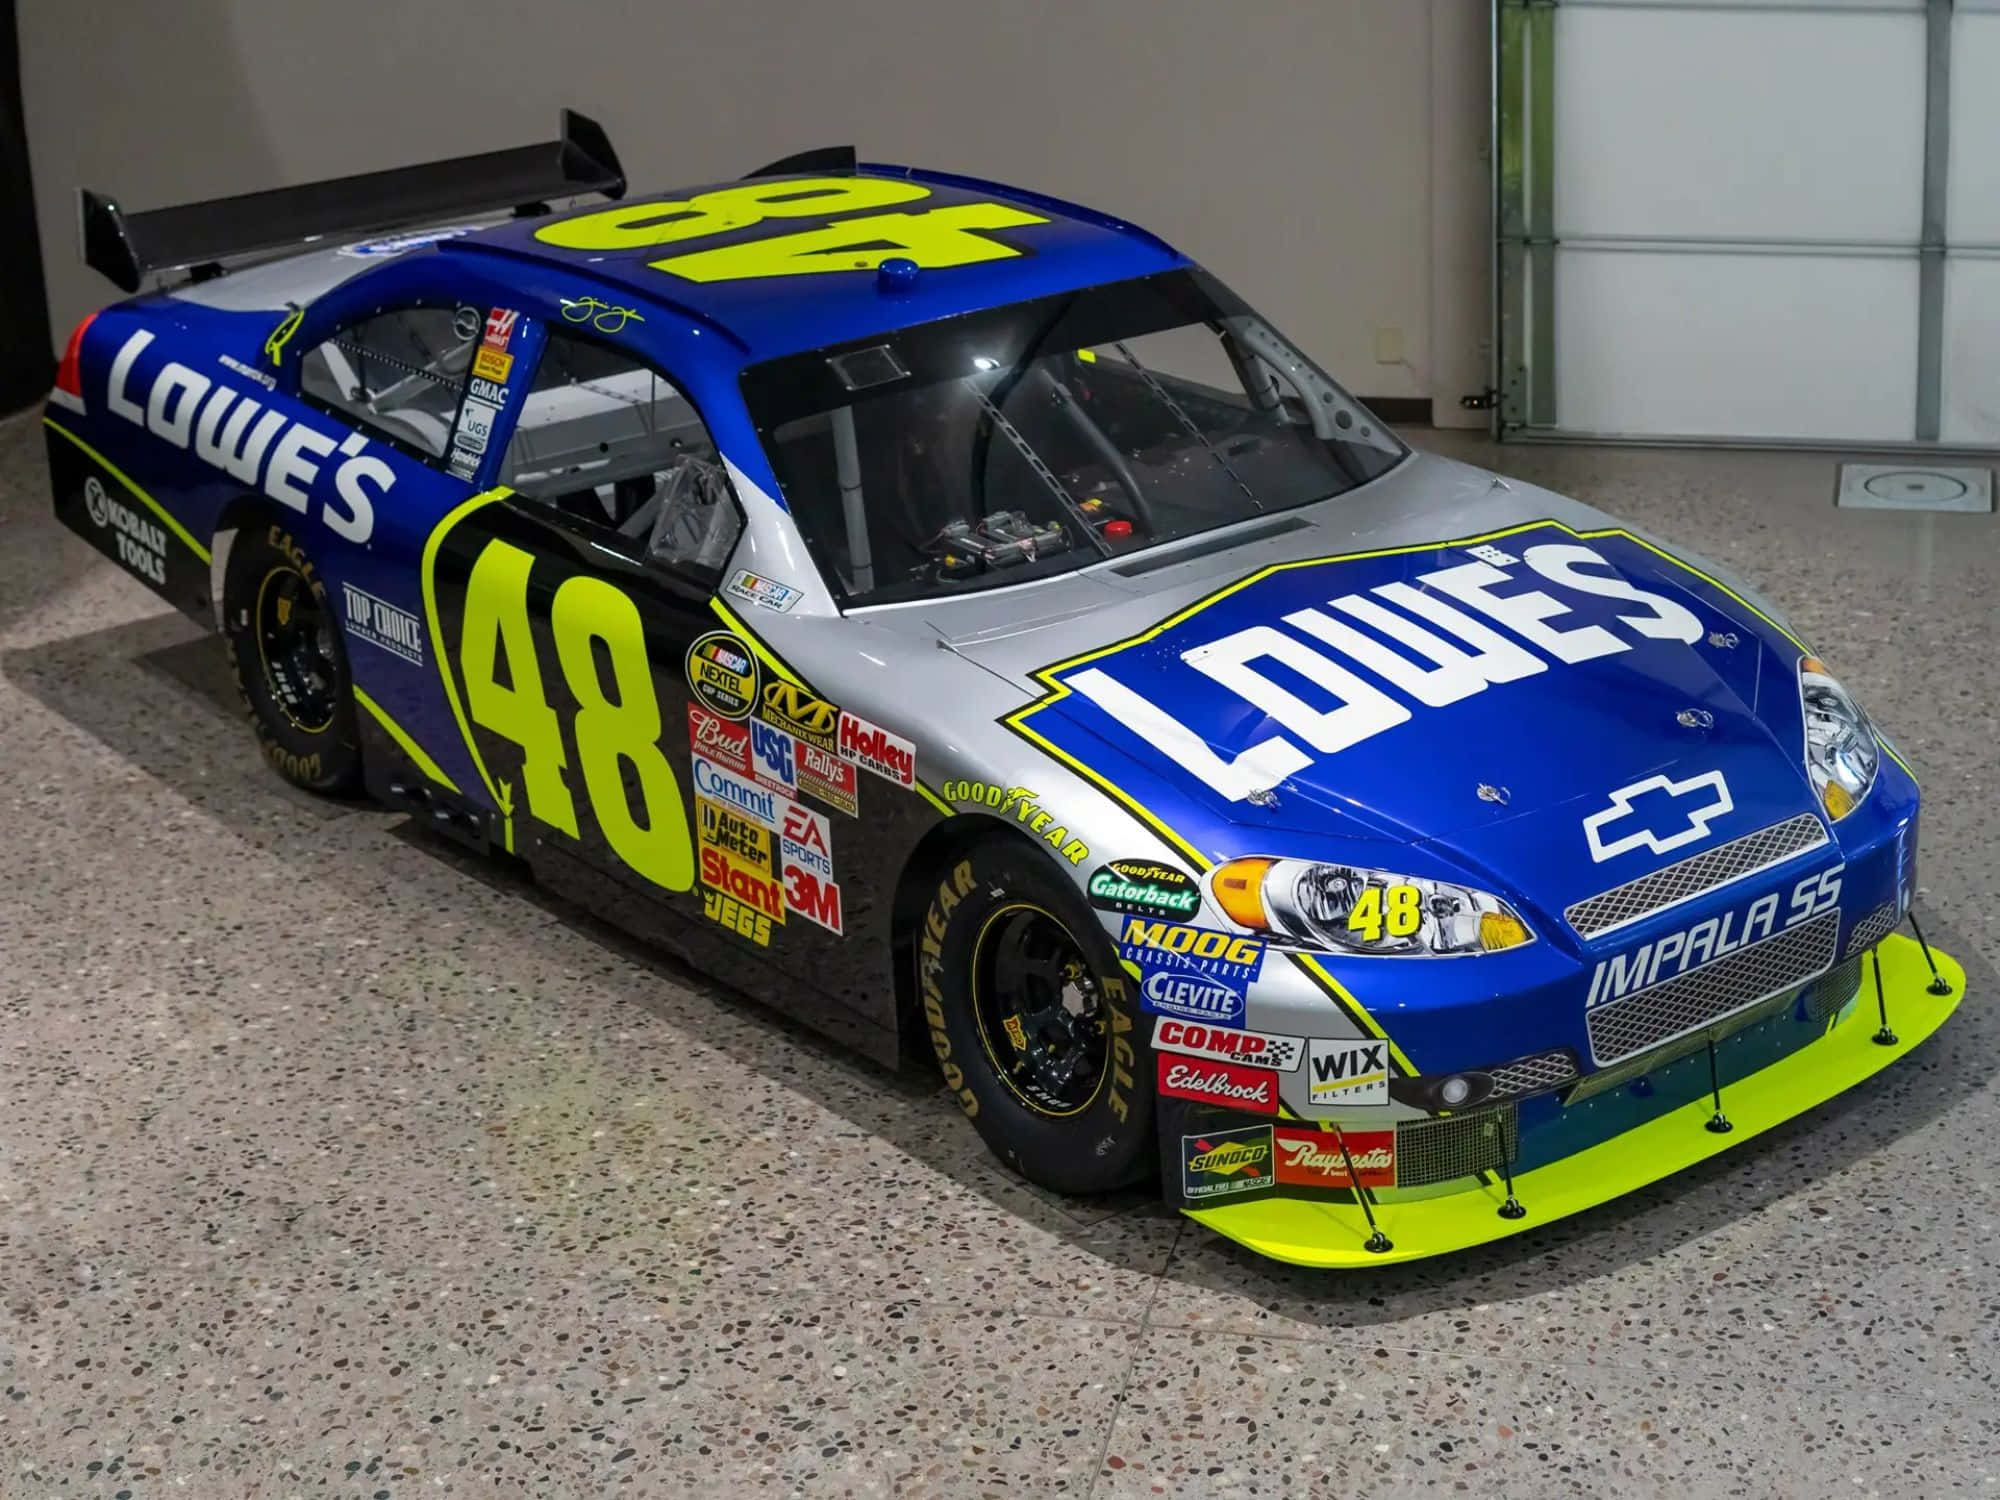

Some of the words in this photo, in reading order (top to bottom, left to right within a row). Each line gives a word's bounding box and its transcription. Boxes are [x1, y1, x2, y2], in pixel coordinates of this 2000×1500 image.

[533, 177, 1052, 283] 48
[470, 378, 510, 404] GMAC
[107, 329, 396, 544] LOWE'S
[467, 420, 488, 437] UGS
[107, 498, 166, 557] KOBALT
[116, 531, 166, 584] TOOLS
[732, 585, 758, 598] RACE
[759, 595, 783, 608] CAR
[342, 587, 371, 627] TOP
[374, 603, 422, 653] CHOICE
[700, 661, 743, 695] NEXTEL
[714, 647, 747, 675] NASCAR
[1063, 544, 1704, 801] LOWE'S
[460, 537, 695, 892] 48
[716, 691, 739, 707] SERIES
[690, 710, 748, 757] Bud
[763, 704, 809, 738] MECHANIX
[809, 732, 835, 752] WEAR
[751, 720, 794, 785] USG
[805, 747, 844, 782] Rally's
[840, 746, 857, 761] HP
[859, 754, 900, 780] CARBS
[841, 715, 912, 784] Holley
[694, 758, 776, 820] Commit
[720, 812, 758, 844] Auto
[784, 805, 828, 857] EA
[943, 780, 1090, 867] GOODYEAR
[716, 827, 767, 864] Meter
[783, 839, 830, 875] SPORTS
[702, 847, 781, 918] Stant
[1090, 872, 1197, 911] Gatorback
[1111, 862, 1186, 884] GOODYEAR
[784, 864, 839, 930] 3M
[1115, 902, 1166, 916] BELTS
[1348, 885, 1422, 942] 48
[703, 893, 771, 947] JEGS
[1585, 905, 1773, 1008] IMPALA
[1785, 863, 1846, 927] SS
[1122, 919, 1263, 965] MOOG
[1126, 947, 1191, 969] CHASSIS
[1200, 960, 1251, 980] PARTS
[1148, 971, 1238, 1013] CLEVITE
[1102, 976, 1135, 1124] EAGLE
[1158, 1021, 1267, 1055] COMP
[1230, 1051, 1282, 1067] CAMS
[1166, 1064, 1269, 1104] Edelbrock
[1312, 1044, 1384, 1082] WIX
[1312, 1081, 1386, 1101] FILTERS
[1191, 1146, 1267, 1170] SUNOCO
